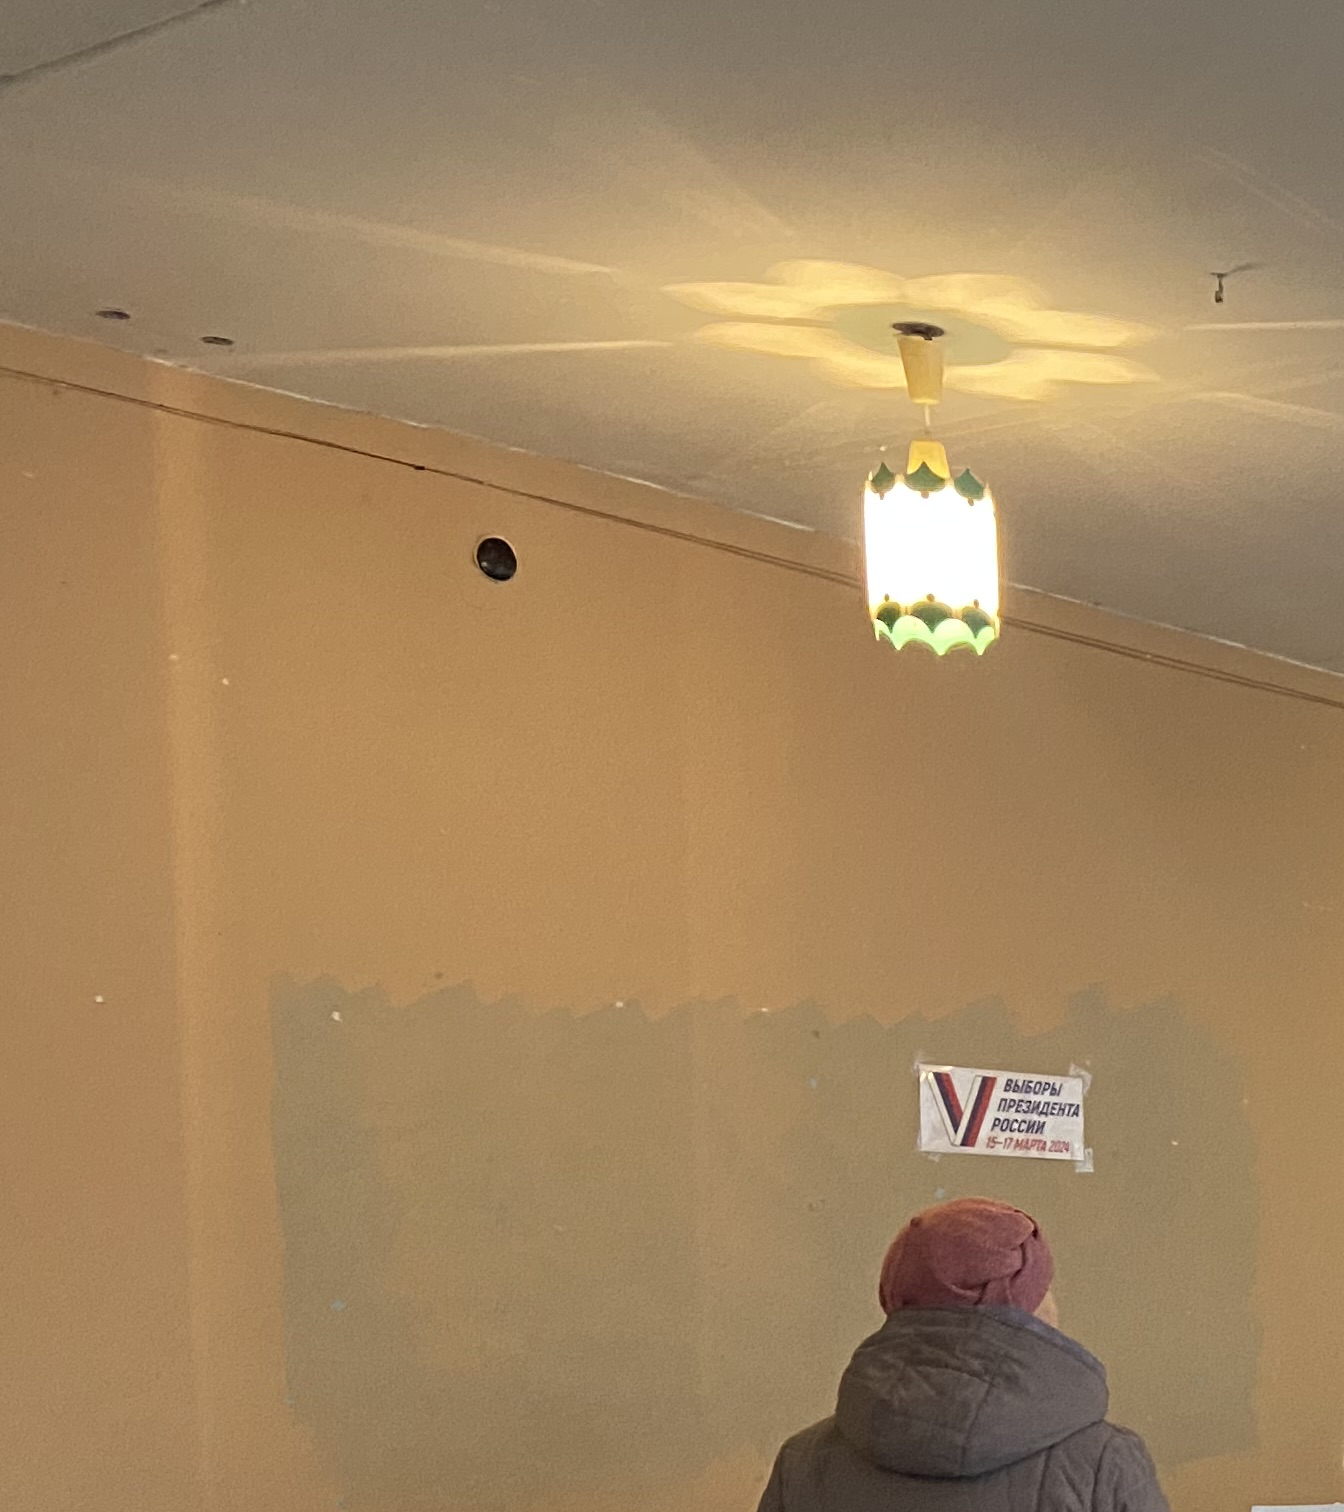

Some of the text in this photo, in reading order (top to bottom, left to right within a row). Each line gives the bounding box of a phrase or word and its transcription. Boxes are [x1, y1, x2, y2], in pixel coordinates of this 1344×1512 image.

[1003, 1078, 1063, 1097] ВЫБОРЫ
[997, 1097, 1080, 1118] ПРЕЗИДЕНТА
[991, 1117, 1046, 1135] РОССИИ
[1013, 1137, 1048, 1153] МАРТА
